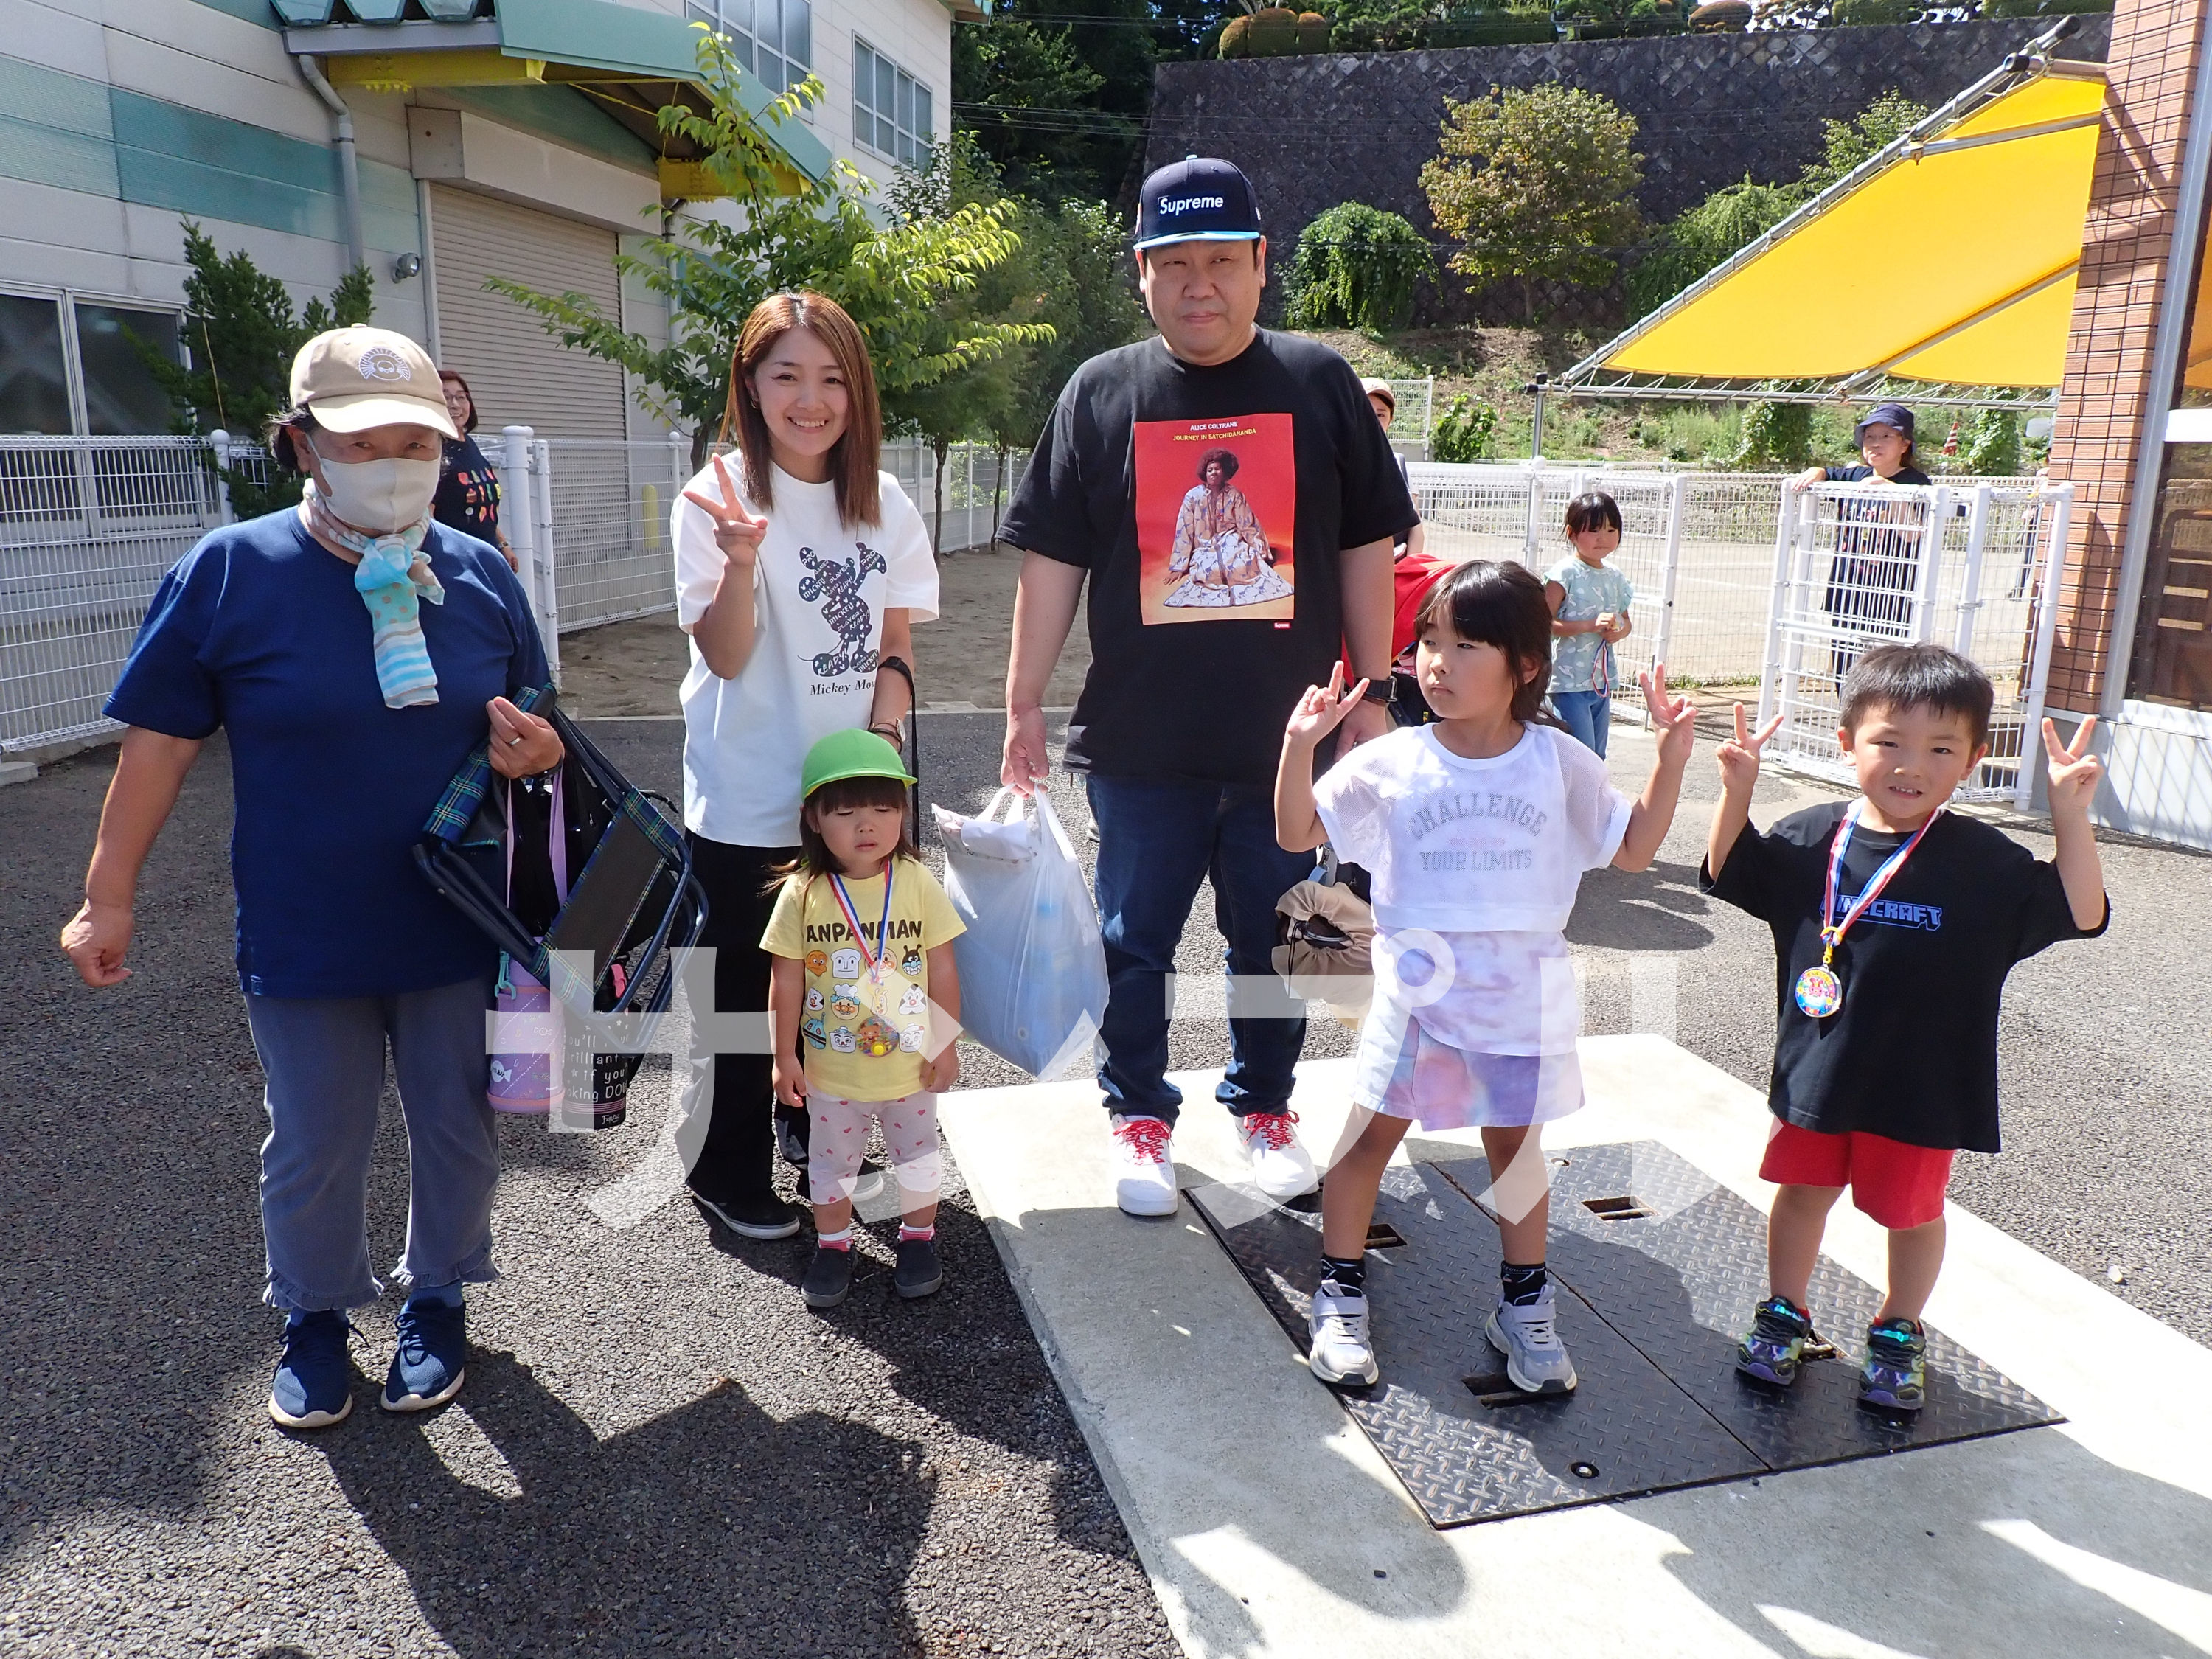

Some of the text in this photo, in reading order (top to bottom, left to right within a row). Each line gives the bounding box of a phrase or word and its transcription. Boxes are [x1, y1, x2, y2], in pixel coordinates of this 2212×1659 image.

[1159, 196, 1224, 216] Supreme
[1208, 421, 1238, 430] COLTRANE
[1208, 428, 1256, 439] SATCHIDANANDA
[860, 550, 876, 566] PRO
[830, 563, 851, 583] PLAYER
[828, 602, 854, 625] MICKEY
[810, 682, 851, 695] Mickey
[1405, 790, 1546, 840] CHALLENGE
[1419, 849, 1532, 872] YOUR LIMITS
[1820, 896, 1941, 925] INCRAFT
[584, 1069, 597, 1082] if
